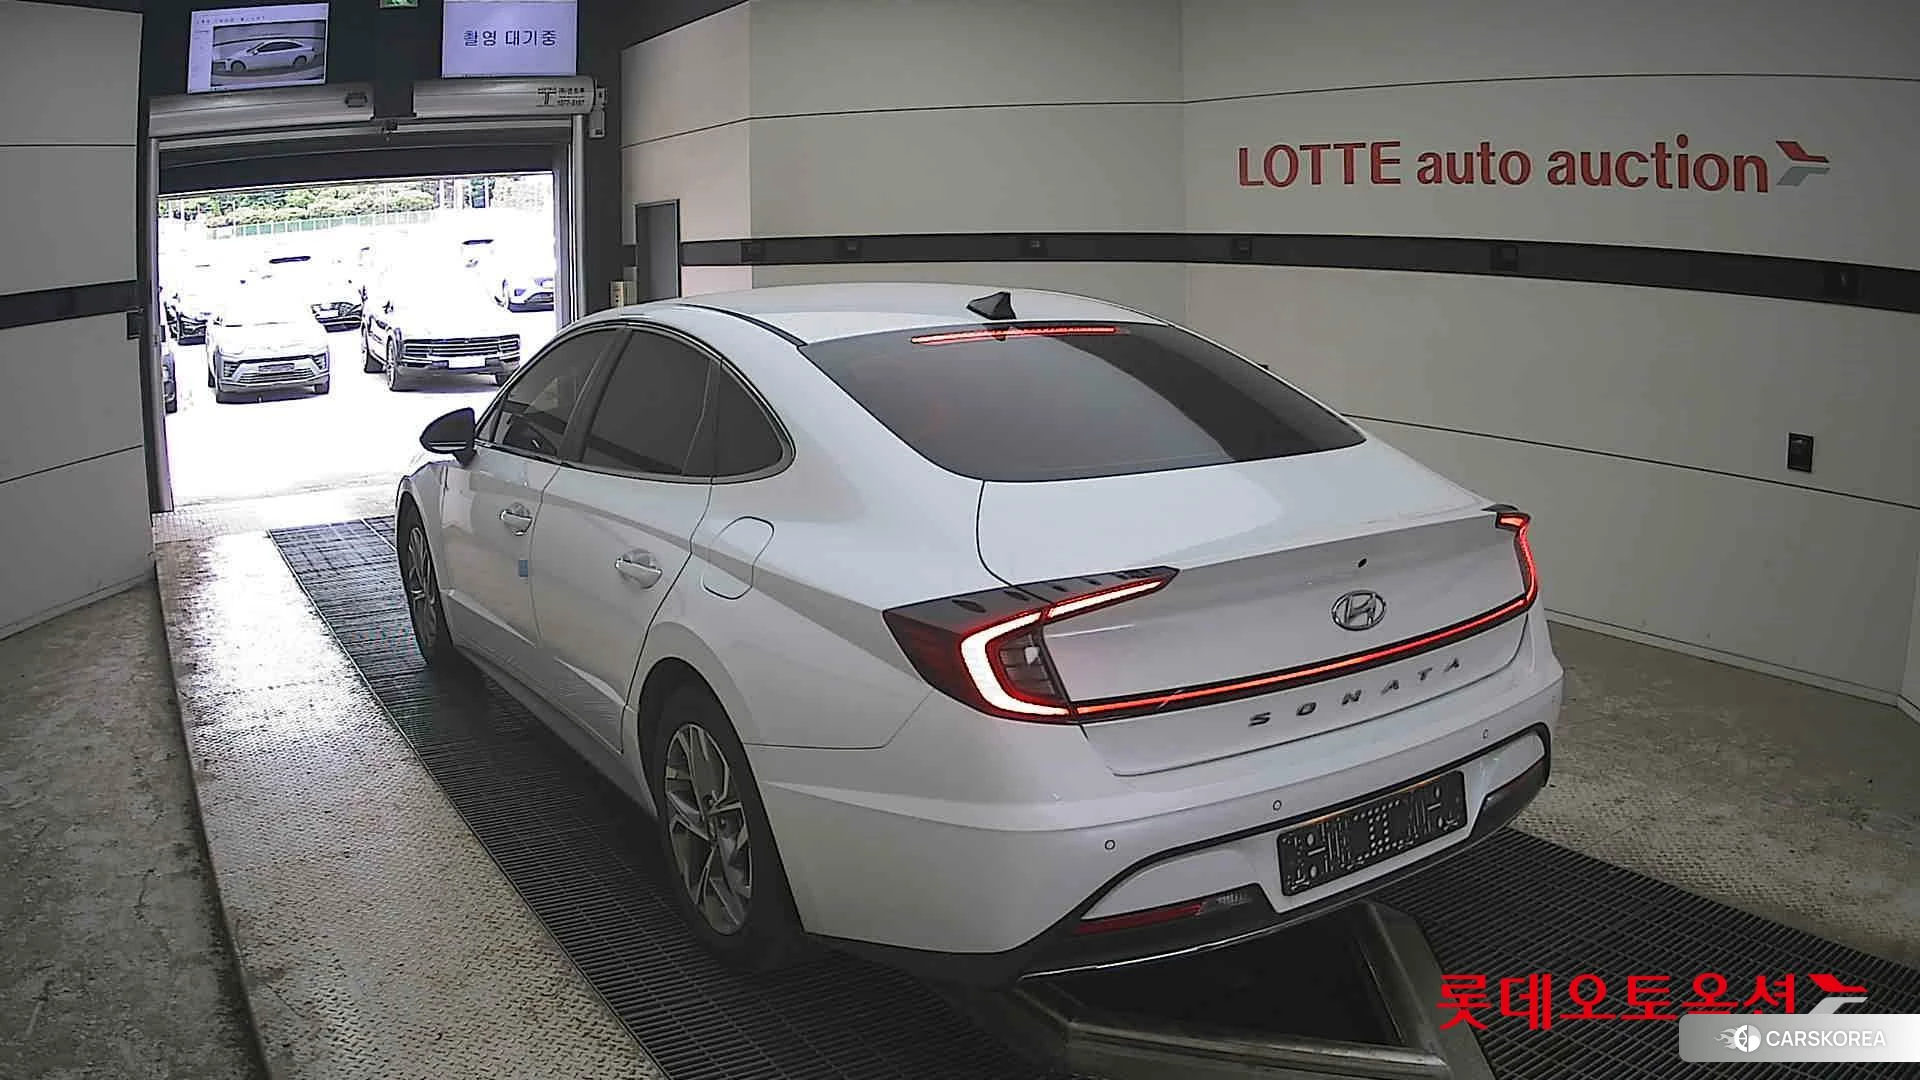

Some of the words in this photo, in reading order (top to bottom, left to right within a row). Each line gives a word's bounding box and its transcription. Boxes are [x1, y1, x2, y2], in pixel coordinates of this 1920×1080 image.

[463, 30, 497, 47] 촬영
[505, 30, 557, 47] 대기중
[1239, 141, 1401, 188] LOTTE
[1417, 141, 1531, 186] auto
[1547, 134, 1769, 193] auction
[1248, 657, 1460, 727] SONATA
